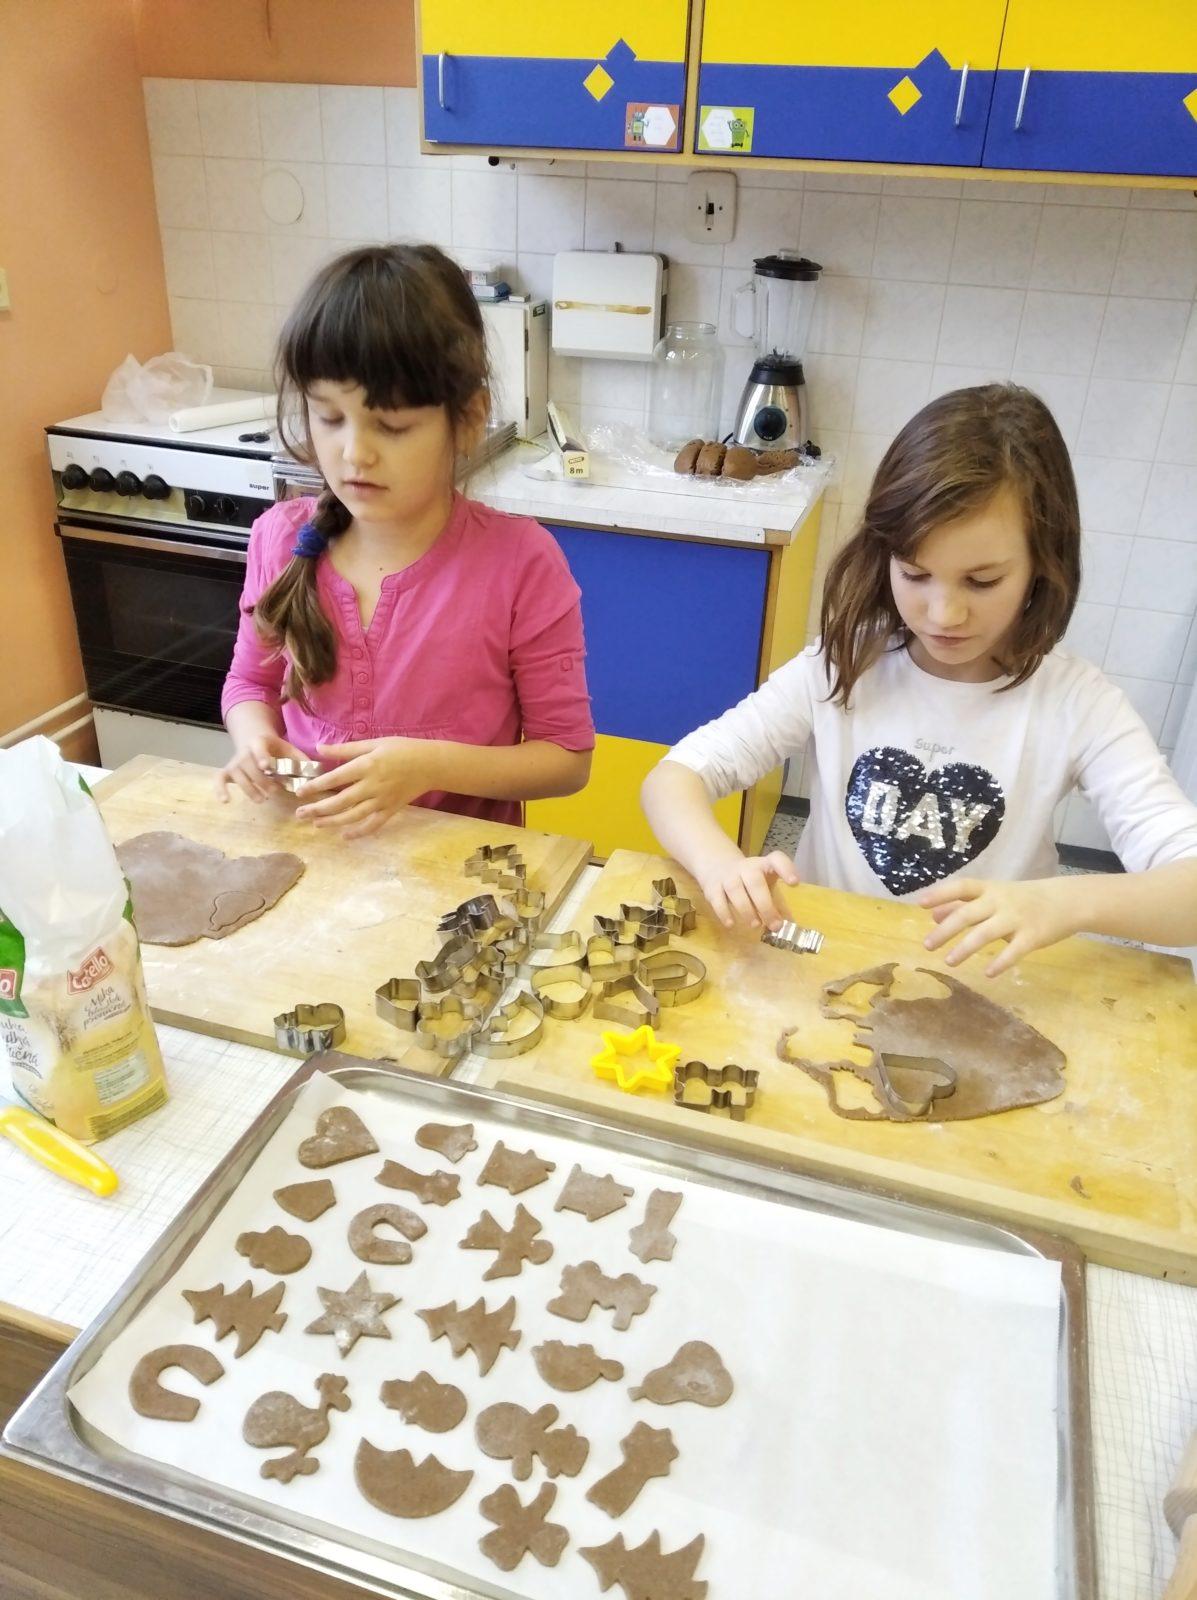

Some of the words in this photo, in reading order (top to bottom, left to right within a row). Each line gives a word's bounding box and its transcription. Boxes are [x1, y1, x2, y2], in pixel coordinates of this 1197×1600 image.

[569, 467, 575, 475] 8
[914, 737, 956, 763] Super
[861, 780, 994, 854] DAY
